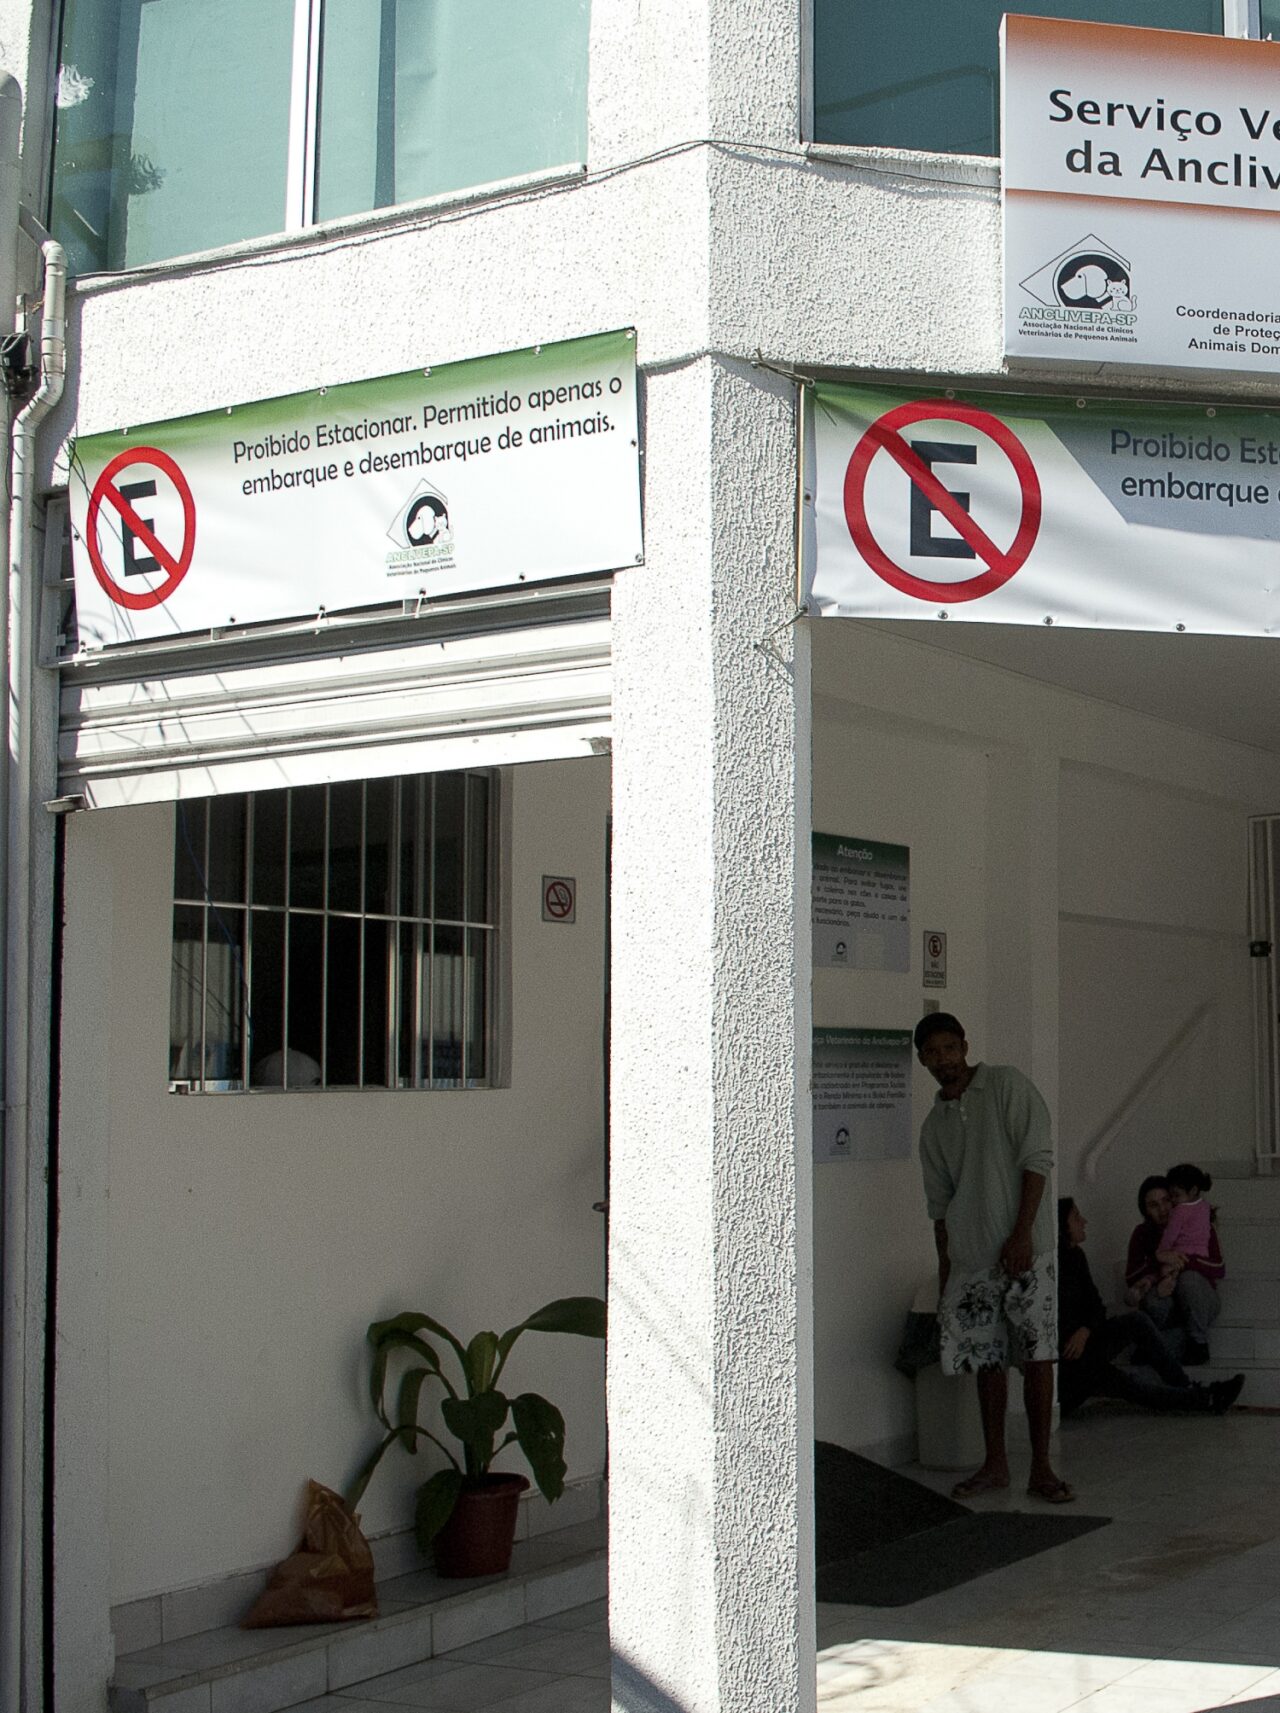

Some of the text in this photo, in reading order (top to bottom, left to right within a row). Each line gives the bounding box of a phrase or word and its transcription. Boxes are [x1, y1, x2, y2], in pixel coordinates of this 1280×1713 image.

[1049, 89, 1222, 141] Serviço
[1065, 140, 1122, 177] da
[1019, 307, 1137, 326] ANCLIVEPA-SP
[1023, 321, 1062, 330] Associação
[1064, 323, 1095, 332] Nacional
[1075, 333, 1108, 342] Pequenos
[1110, 335, 1138, 343] Animais
[1213, 324, 1231, 336] de
[1188, 338, 1247, 353] Animais
[233, 377, 622, 463] Proibido Estacionar. Permitido apenas o
[242, 411, 615, 495] embarque e desembarque de animais.
[1111, 429, 1230, 462] Proibido
[1121, 472, 1269, 507] embarque
[837, 844, 873, 862] Atenção
